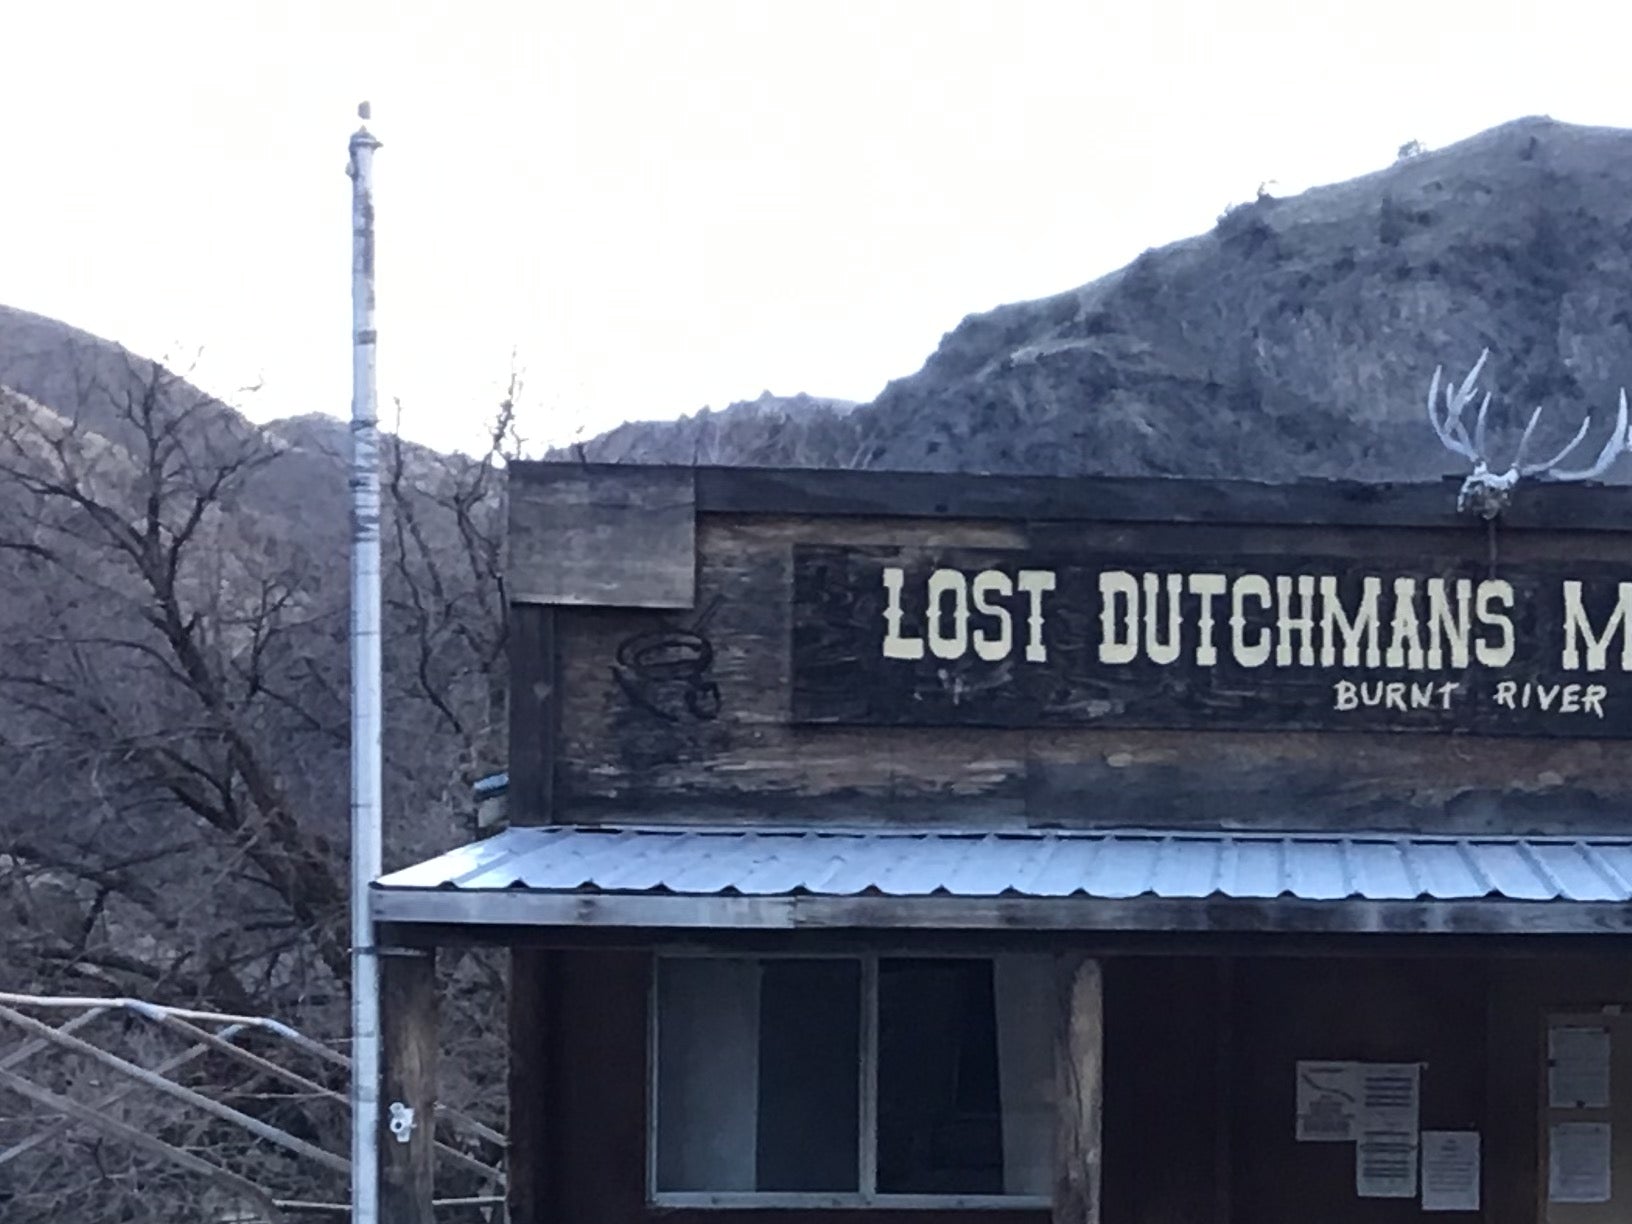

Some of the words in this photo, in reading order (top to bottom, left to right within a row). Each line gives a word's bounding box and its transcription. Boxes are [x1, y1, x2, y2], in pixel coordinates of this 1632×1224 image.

[883, 567, 1055, 662] LOST
[1099, 571, 1514, 669] DUTCHMANS
[1333, 680, 1458, 711] BURNT
[1493, 681, 1608, 718] RIVER
